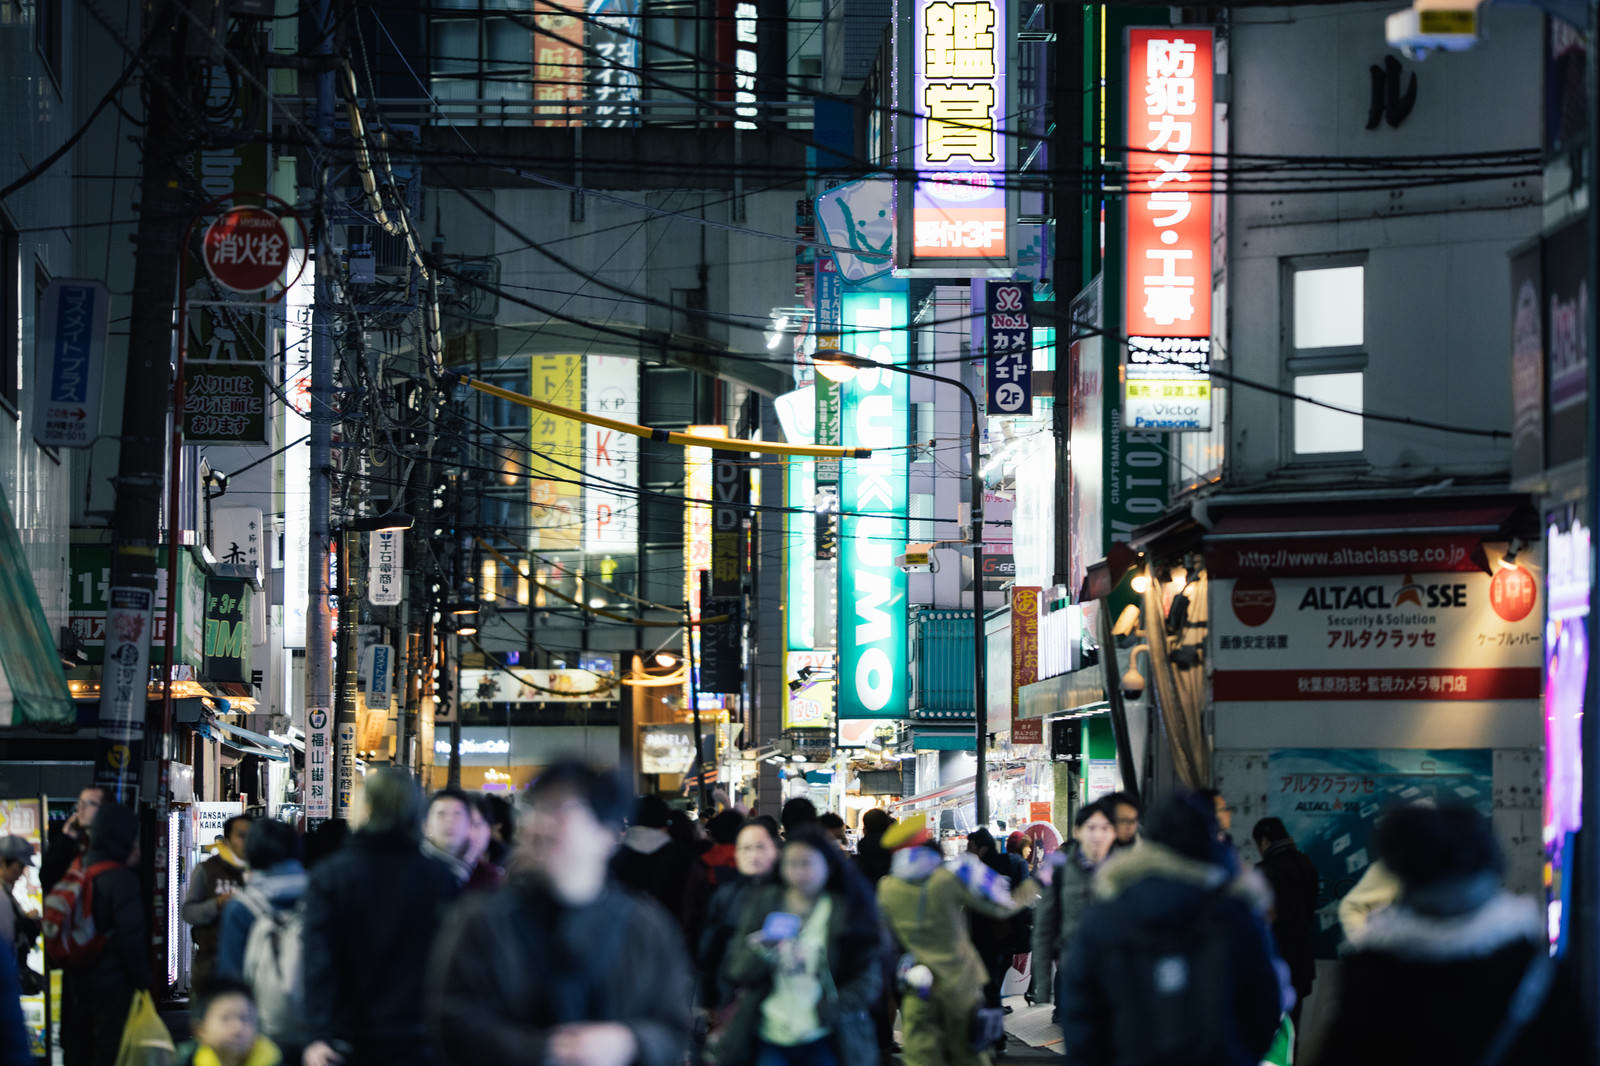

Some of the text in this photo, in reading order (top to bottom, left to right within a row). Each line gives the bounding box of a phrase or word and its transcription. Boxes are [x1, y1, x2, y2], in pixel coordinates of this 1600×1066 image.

[213, 232, 284, 265] 消火栓
[992, 314, 1029, 329] No.1
[189, 375, 254, 394] 入り口は
[1000, 389, 1020, 405] 2F
[192, 416, 250, 435] あります
[856, 298, 893, 710] TSUKUMO
[1238, 545, 1465, 568] http://www.altaclasse.co.jp
[1328, 629, 1436, 649] アルタクラッセ
[1280, 776, 1375, 793] アルタクラッセ
